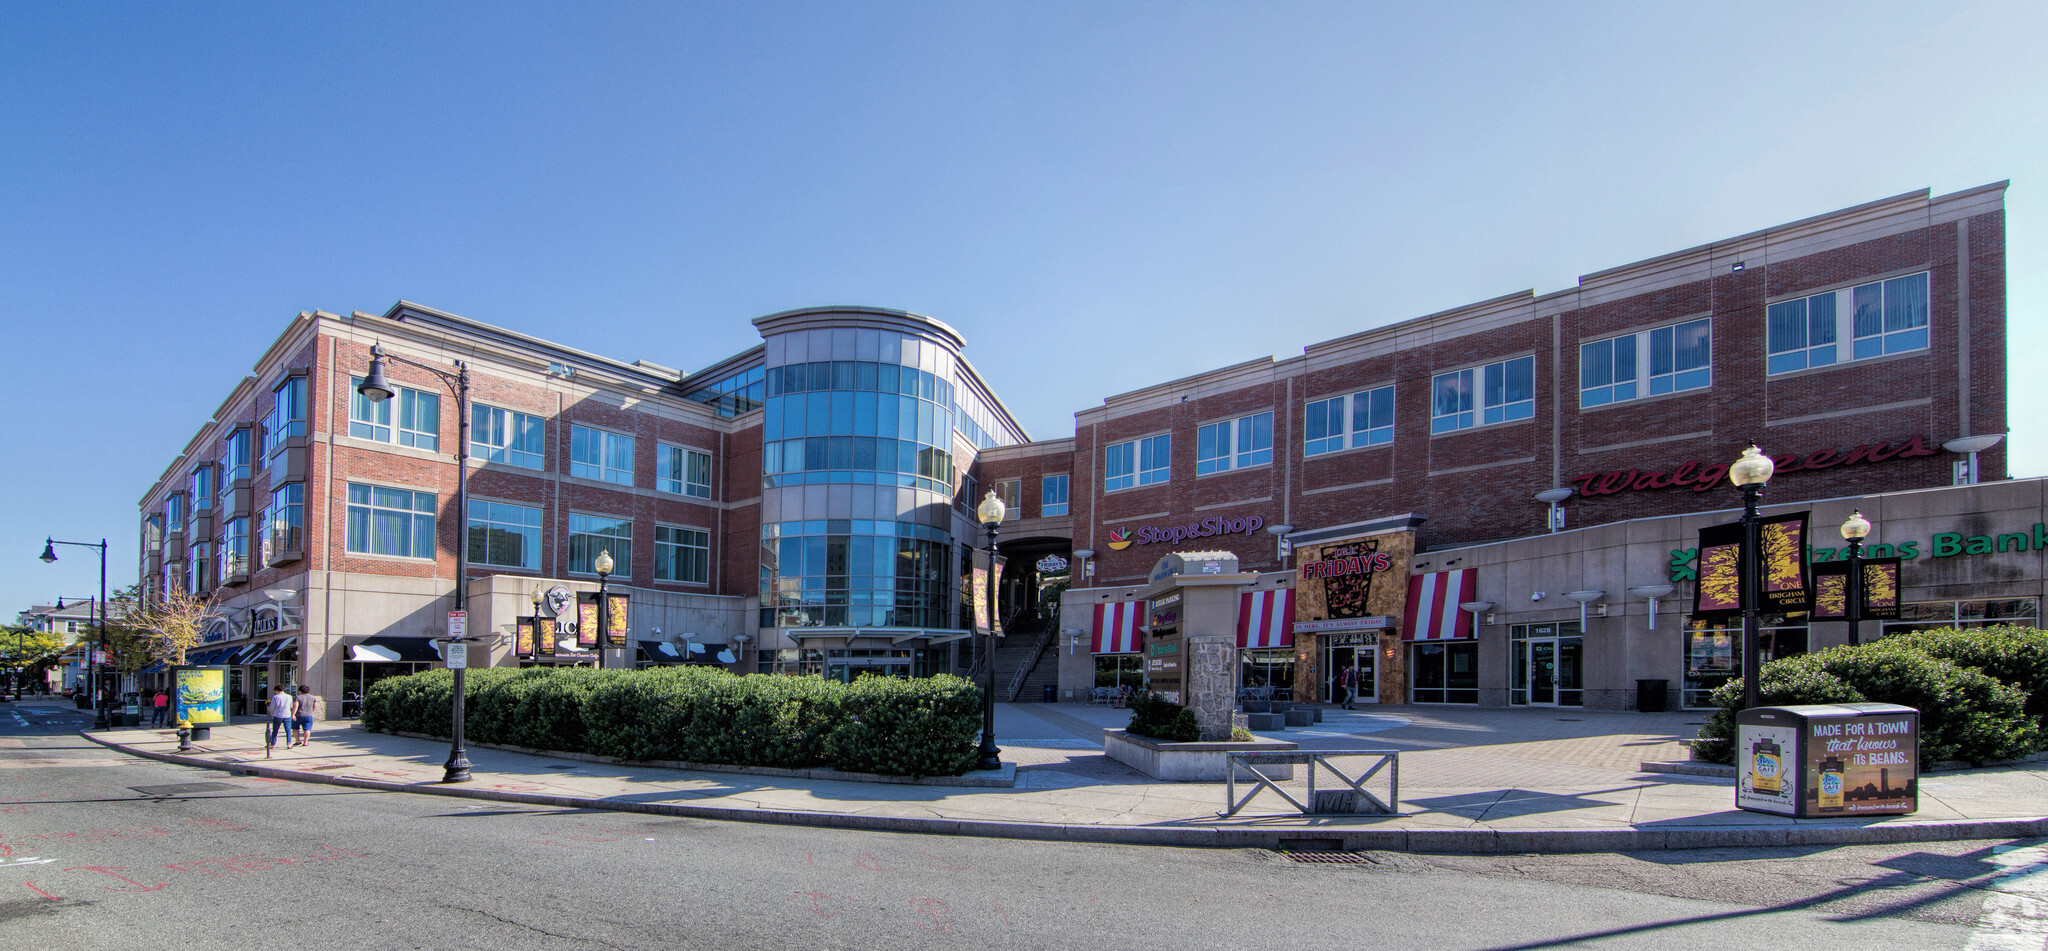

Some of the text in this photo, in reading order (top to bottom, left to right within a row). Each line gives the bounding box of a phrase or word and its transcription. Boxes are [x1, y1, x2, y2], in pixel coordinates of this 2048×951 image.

[1573, 434, 1939, 496] Walgeens
[1138, 515, 1263, 545] Stop&Shop
[1780, 581, 1803, 590] ONE
[1769, 590, 1805, 599] BRIGHAM
[1779, 597, 1806, 605] CIRCLE
[1813, 720, 1909, 737] MADE FOR A TOWN
[1825, 736, 1897, 752] that knows
[1869, 751, 1909, 765] BEANS.
[1317, 792, 1356, 814] MH
